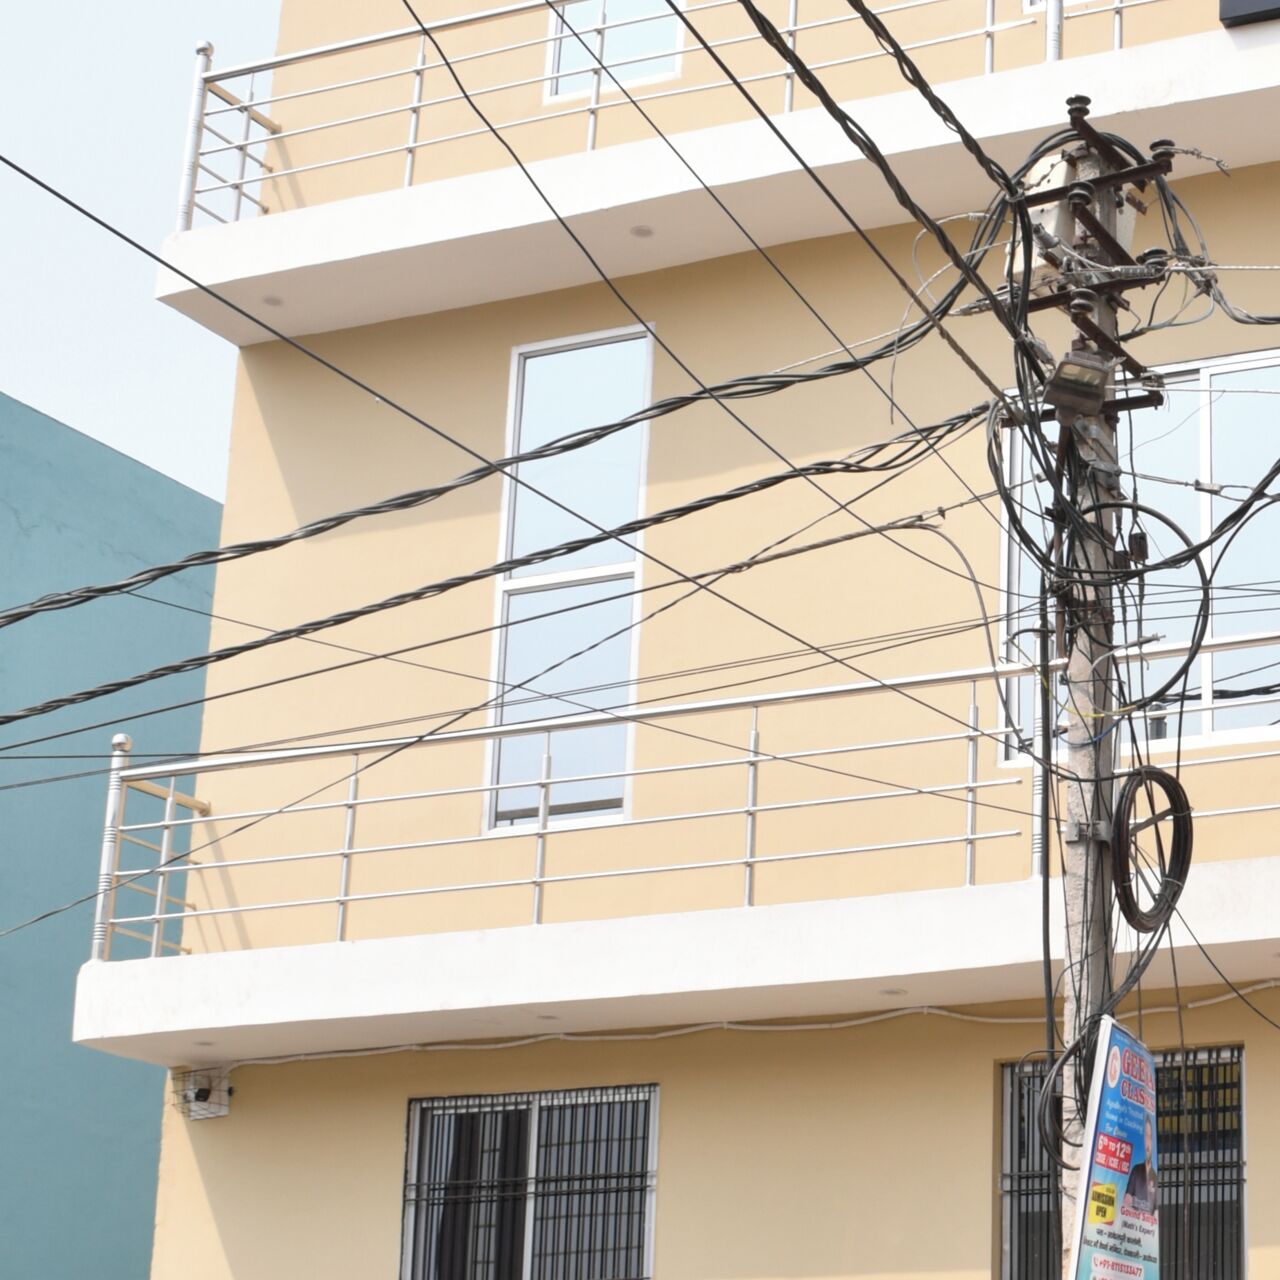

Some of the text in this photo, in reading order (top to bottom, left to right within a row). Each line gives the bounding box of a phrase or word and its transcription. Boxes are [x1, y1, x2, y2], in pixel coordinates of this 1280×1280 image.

[1098, 1135, 1109, 1150] 6th
[1115, 1142, 1131, 1158] 12th
[1095, 1206, 1107, 1218] OPEN
[1120, 1206, 1141, 1219] Govind
